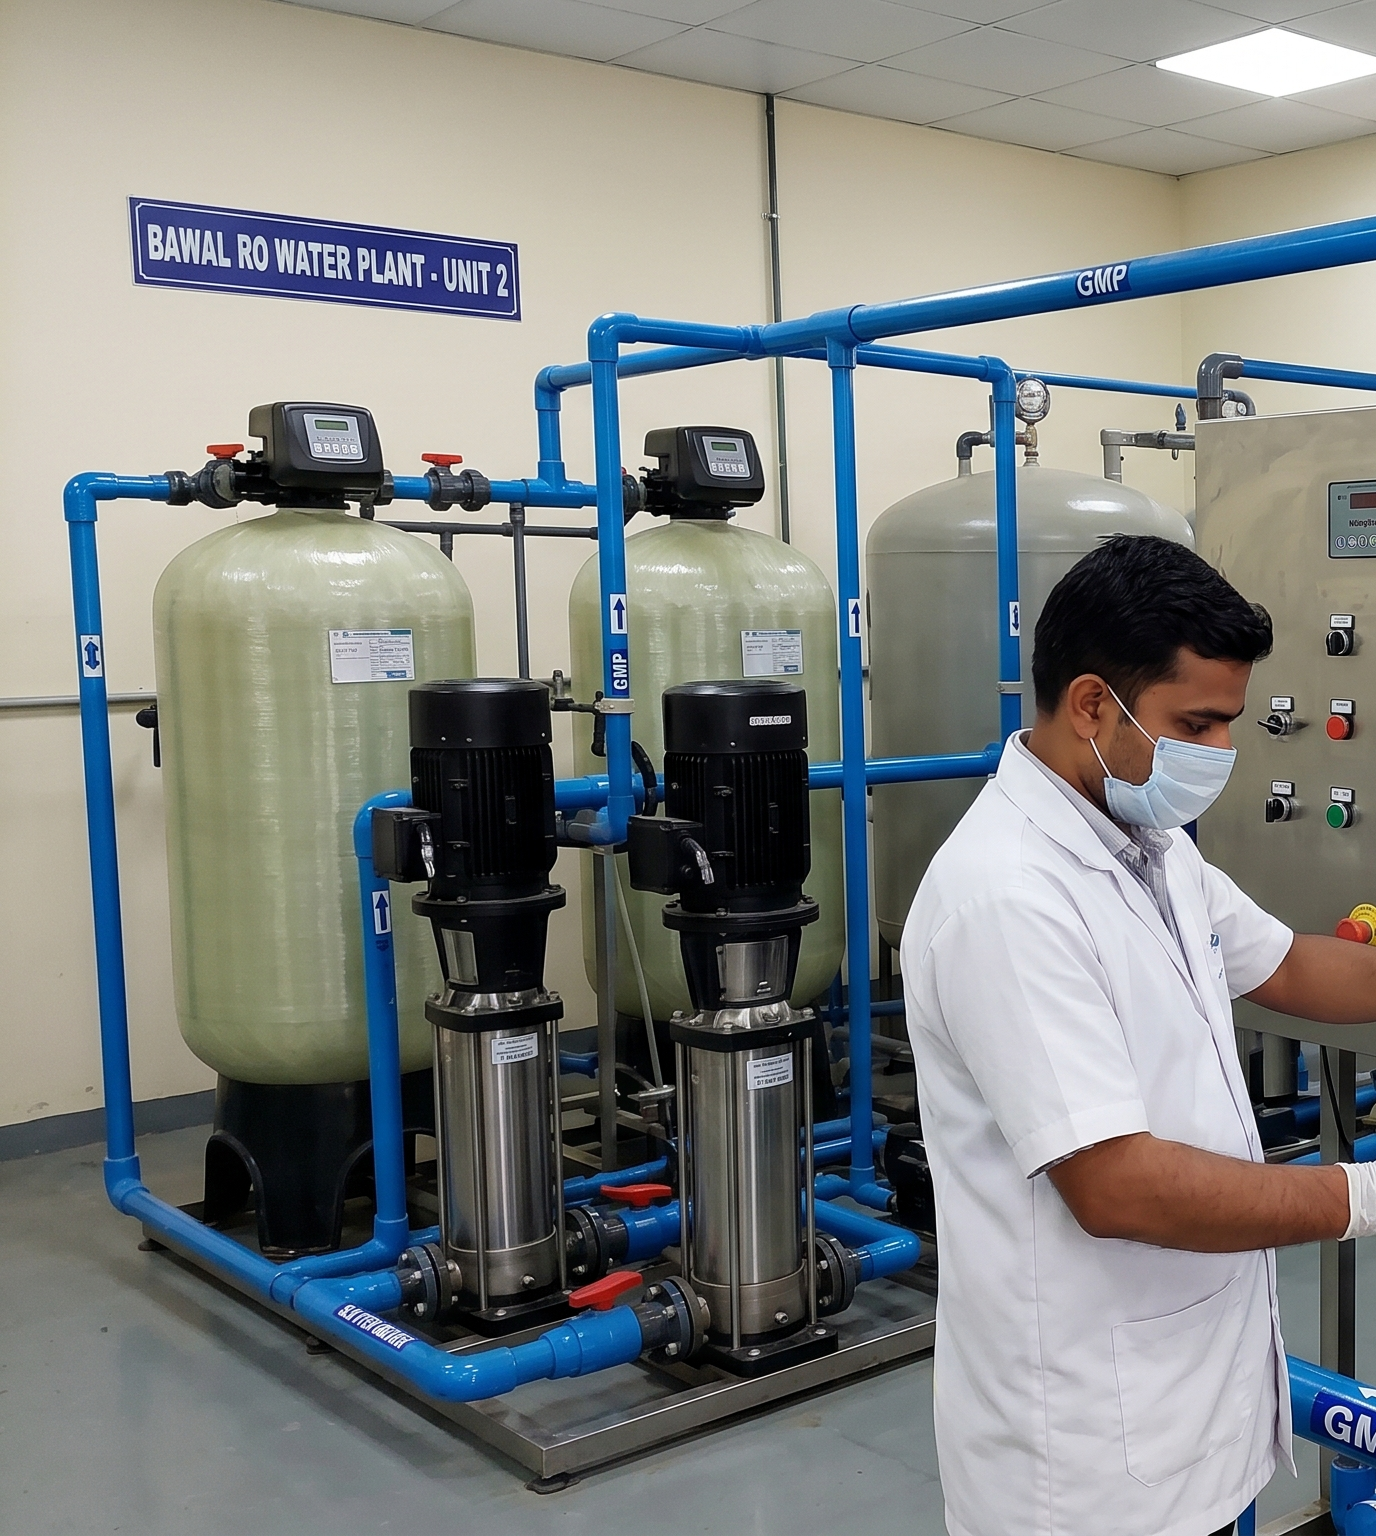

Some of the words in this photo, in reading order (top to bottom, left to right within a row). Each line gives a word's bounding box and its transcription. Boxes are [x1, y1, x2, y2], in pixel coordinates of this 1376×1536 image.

[147, 223, 231, 268] BAWAL
[237, 234, 269, 272] RO
[274, 238, 352, 281] WATER
[357, 247, 425, 288] PLANT
[443, 257, 491, 295] UNIT
[496, 263, 509, 298] 2
[1077, 264, 1128, 297] GMP
[612, 653, 628, 690] GMP
